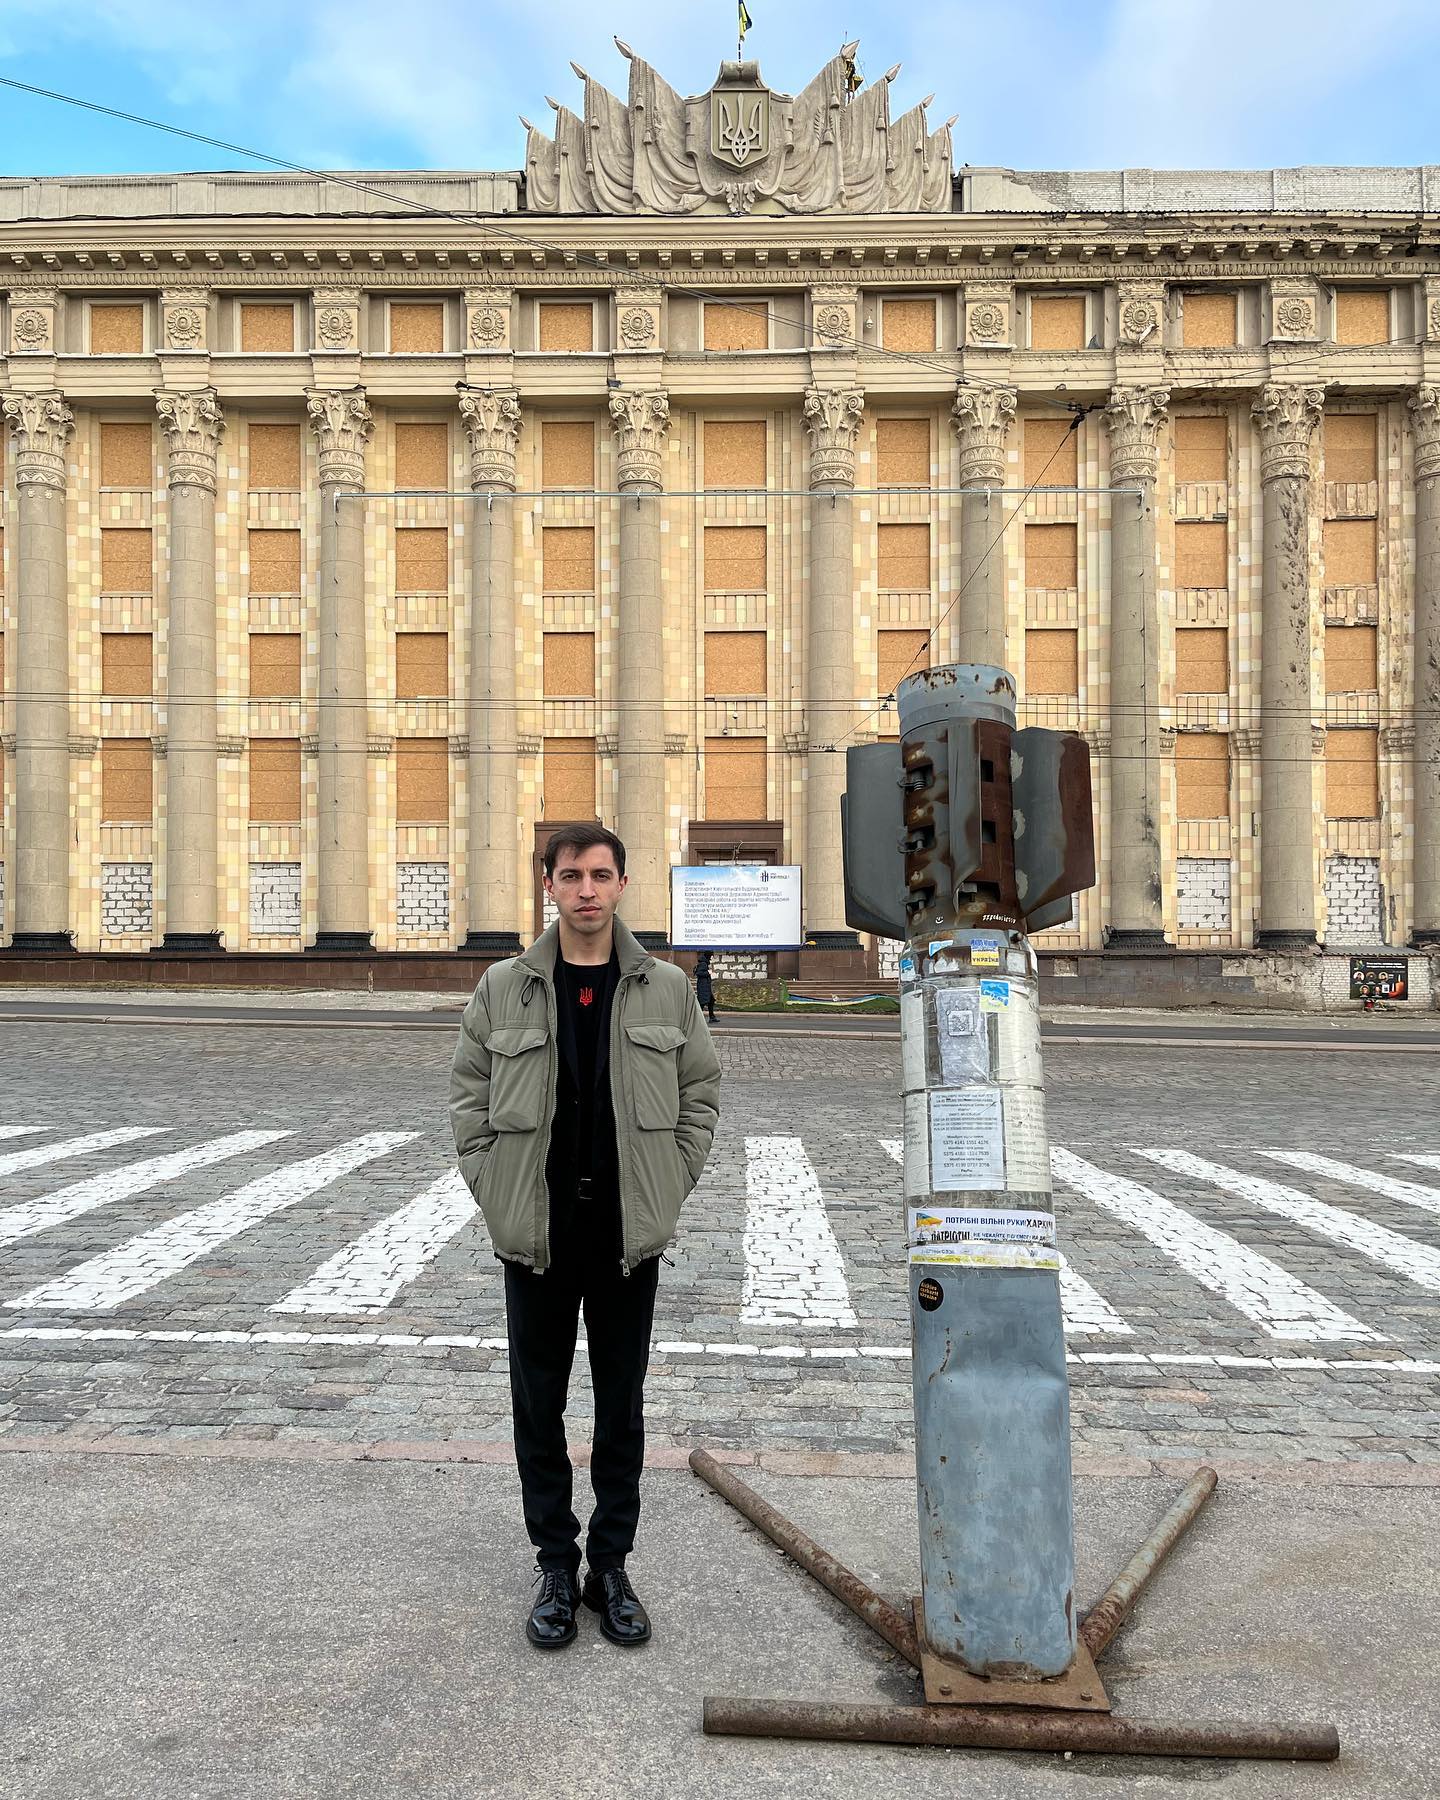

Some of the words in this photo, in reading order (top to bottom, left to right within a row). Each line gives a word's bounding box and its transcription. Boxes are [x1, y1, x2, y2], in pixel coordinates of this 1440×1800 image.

[946, 1216, 979, 1225] ПОТРІБНІ
[980, 1217, 1005, 1225] ВІЛЬНІ
[932, 1230, 970, 1241] ПАТРІОТИ!
